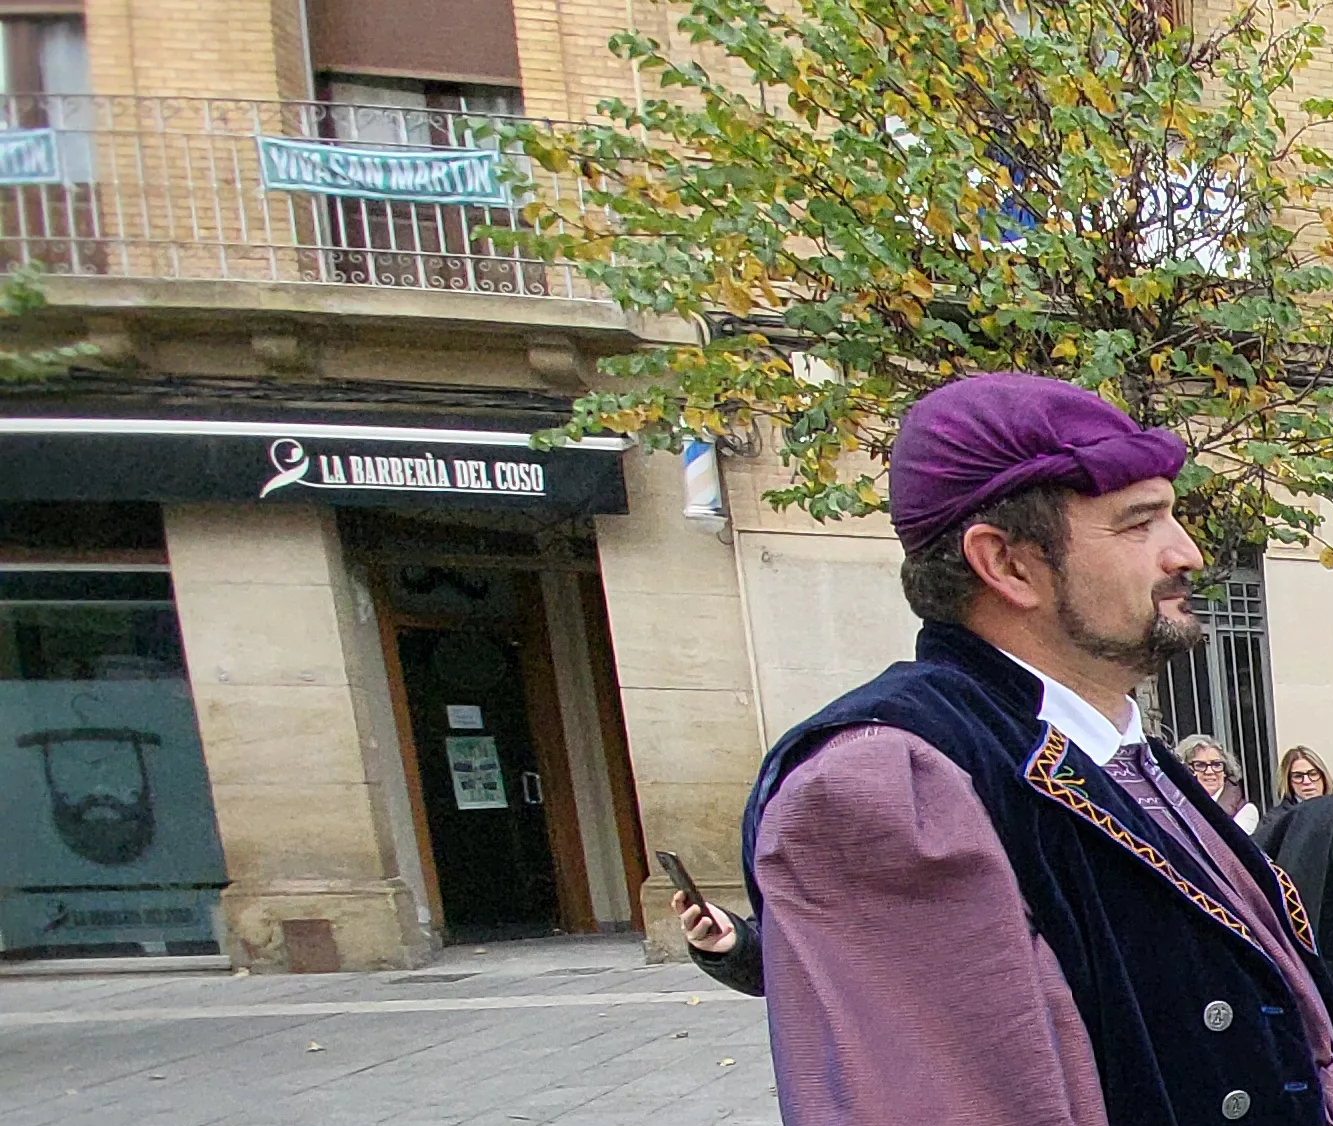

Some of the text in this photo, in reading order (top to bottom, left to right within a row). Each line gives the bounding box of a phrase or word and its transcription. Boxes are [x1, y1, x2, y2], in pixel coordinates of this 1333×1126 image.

[269, 145, 493, 194] VIVA SAN MARTIN
[319, 455, 347, 484] LA
[454, 459, 493, 489] DEL
[493, 461, 545, 492] COSO
